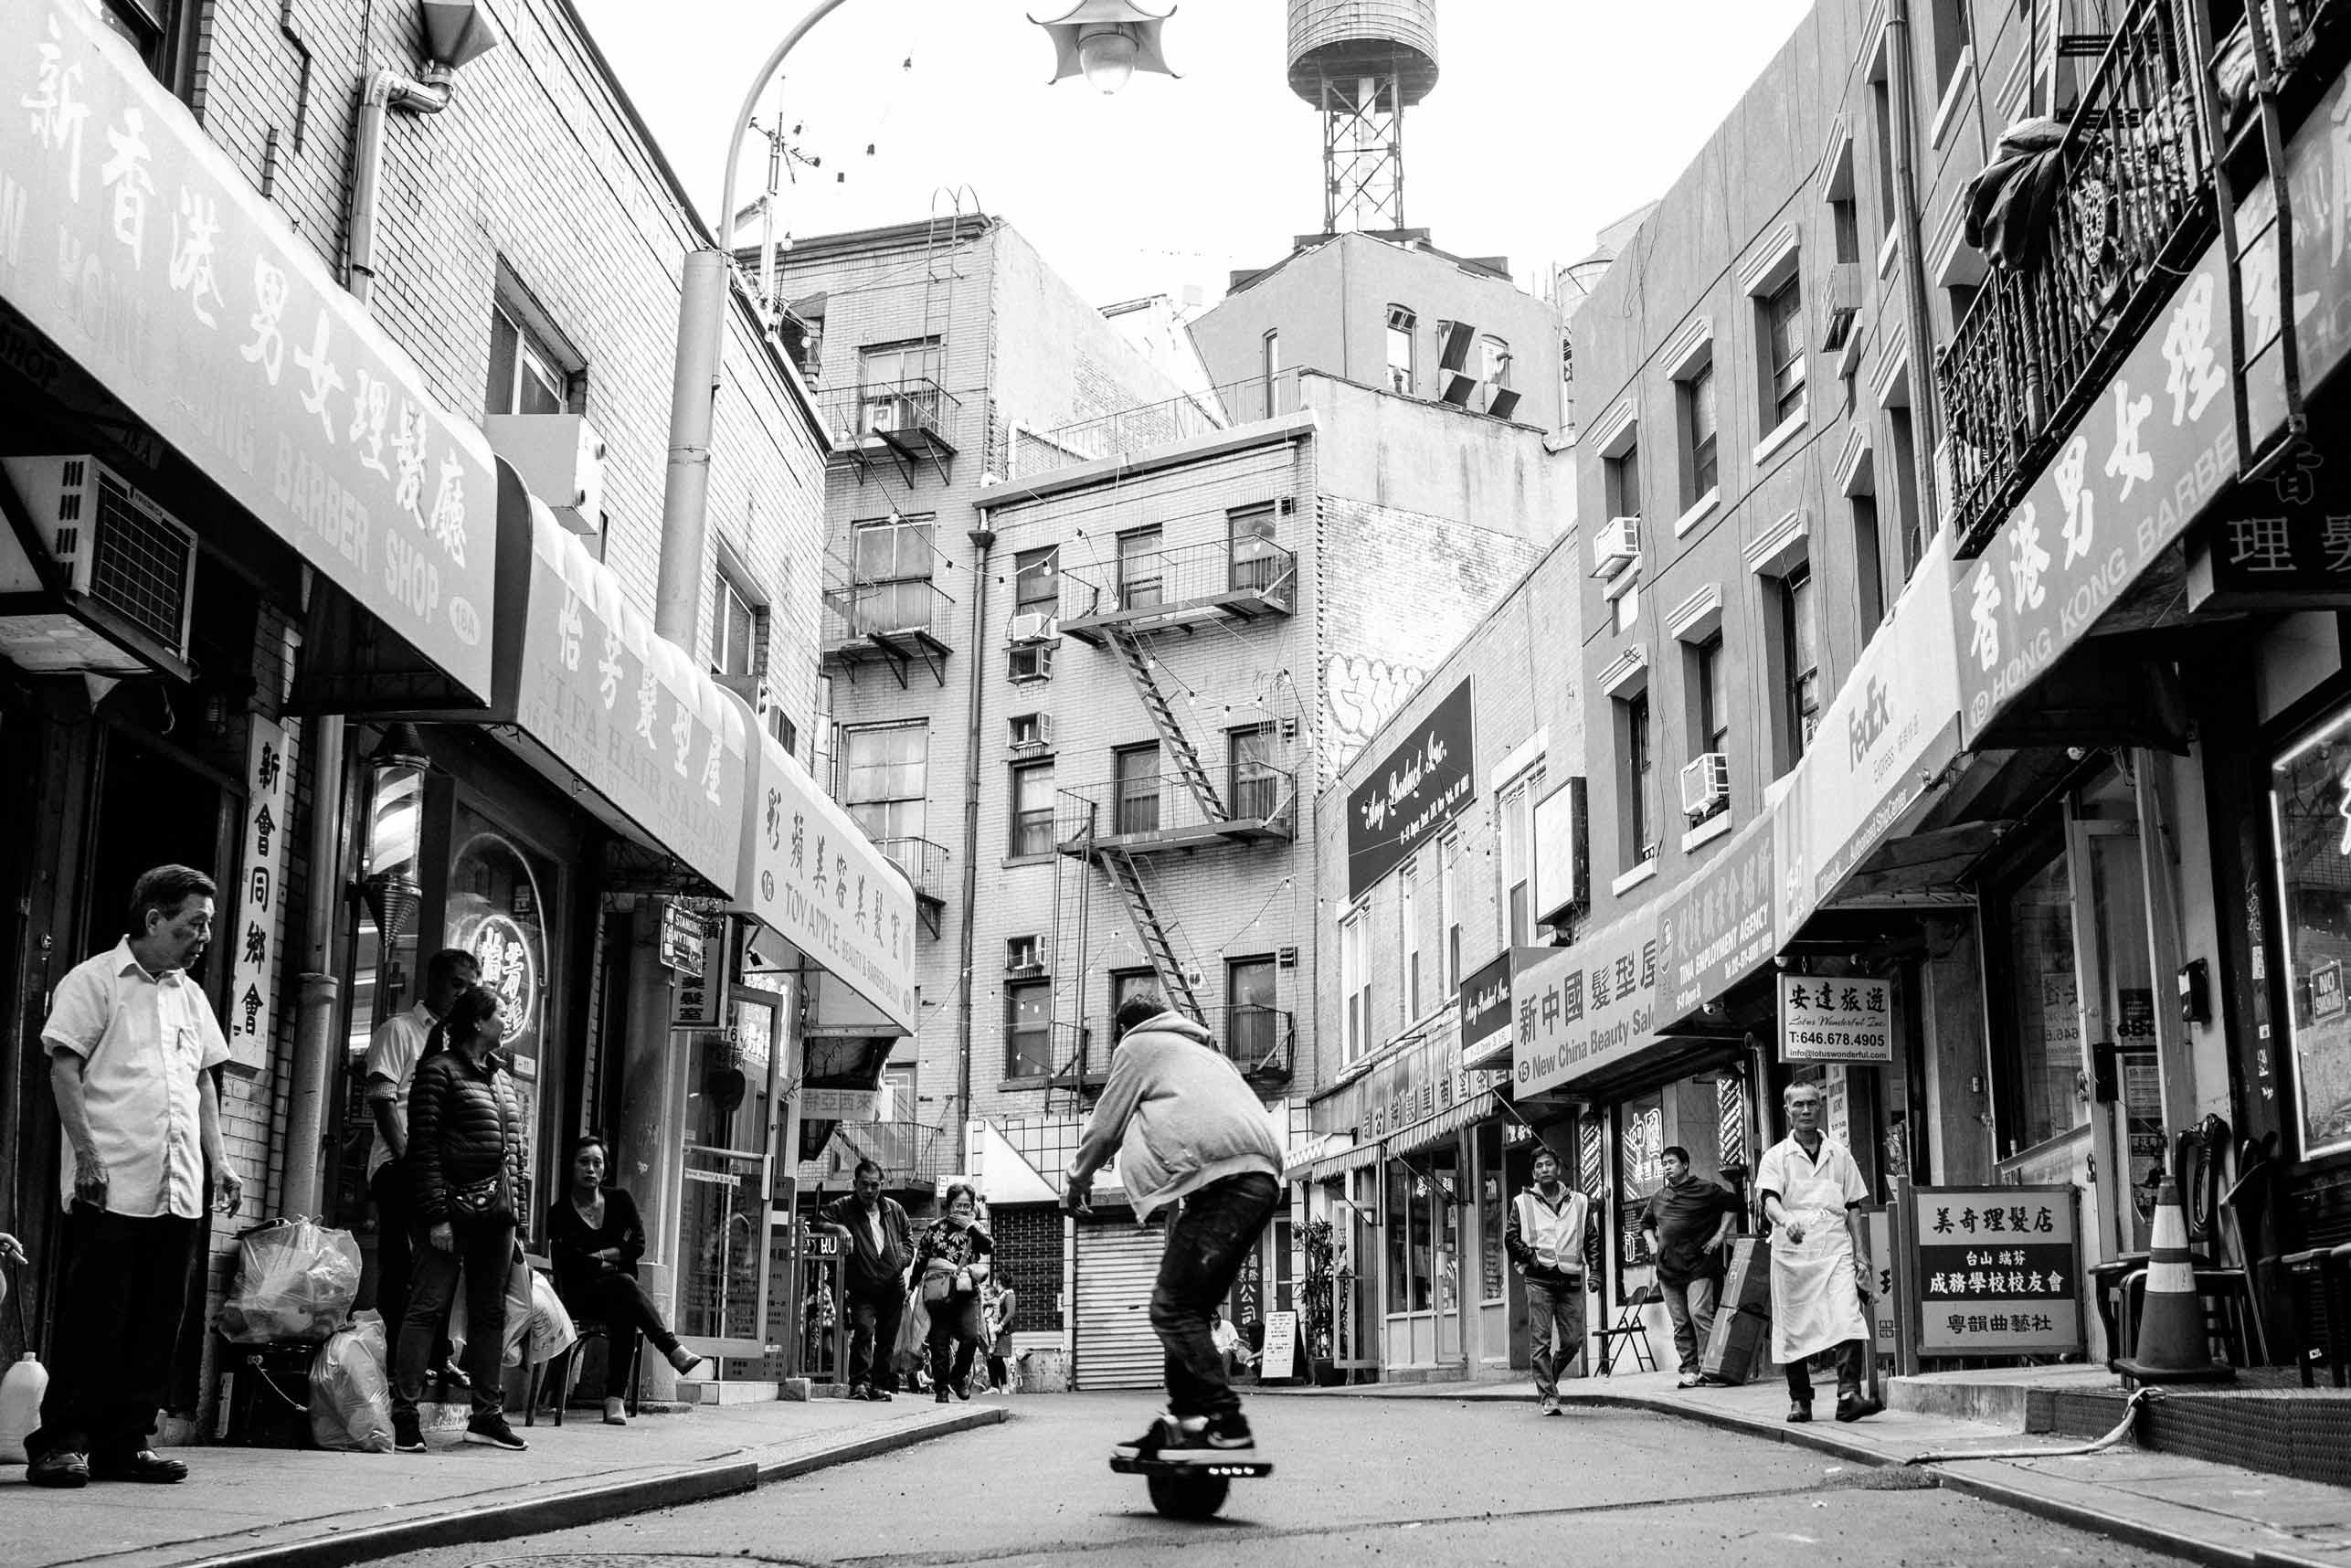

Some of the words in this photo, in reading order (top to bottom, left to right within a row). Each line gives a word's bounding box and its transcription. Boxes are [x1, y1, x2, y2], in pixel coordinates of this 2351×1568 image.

[384, 527, 439, 626] SHOP
[1993, 627, 2053, 705] HONG
[2059, 558, 2128, 636] KONG
[1848, 674, 1890, 773] FedEx
[241, 741, 280, 1036] 新會同鄉會
[808, 905, 839, 957] APPLE
[1680, 959, 1696, 986] TINA
[1696, 927, 1738, 974] EMPLOYMENT
[1740, 901, 1769, 944] AGENCY
[1788, 980, 1886, 1013] 安達旅遊
[2319, 971, 2335, 994] NO
[1788, 1015, 1816, 1026] Lotus
[1867, 1016, 1886, 1027] Inc.
[1533, 1052, 1555, 1079] New
[1558, 1040, 1587, 1068] China
[1590, 1020, 1629, 1054] Beauty
[1788, 1031, 1885, 1046] T:646.678.4905
[1790, 1050, 1887, 1059] info@lotuswonderful.com
[1933, 1205, 2054, 1234] 美奇理髮店
[1965, 1250, 1993, 1266] 台山
[1929, 1270, 2065, 1295] 成務學校校友會
[1239, 1283, 1257, 1326] 公司
[1947, 1314, 2053, 1334] 粵韻曲藝社
